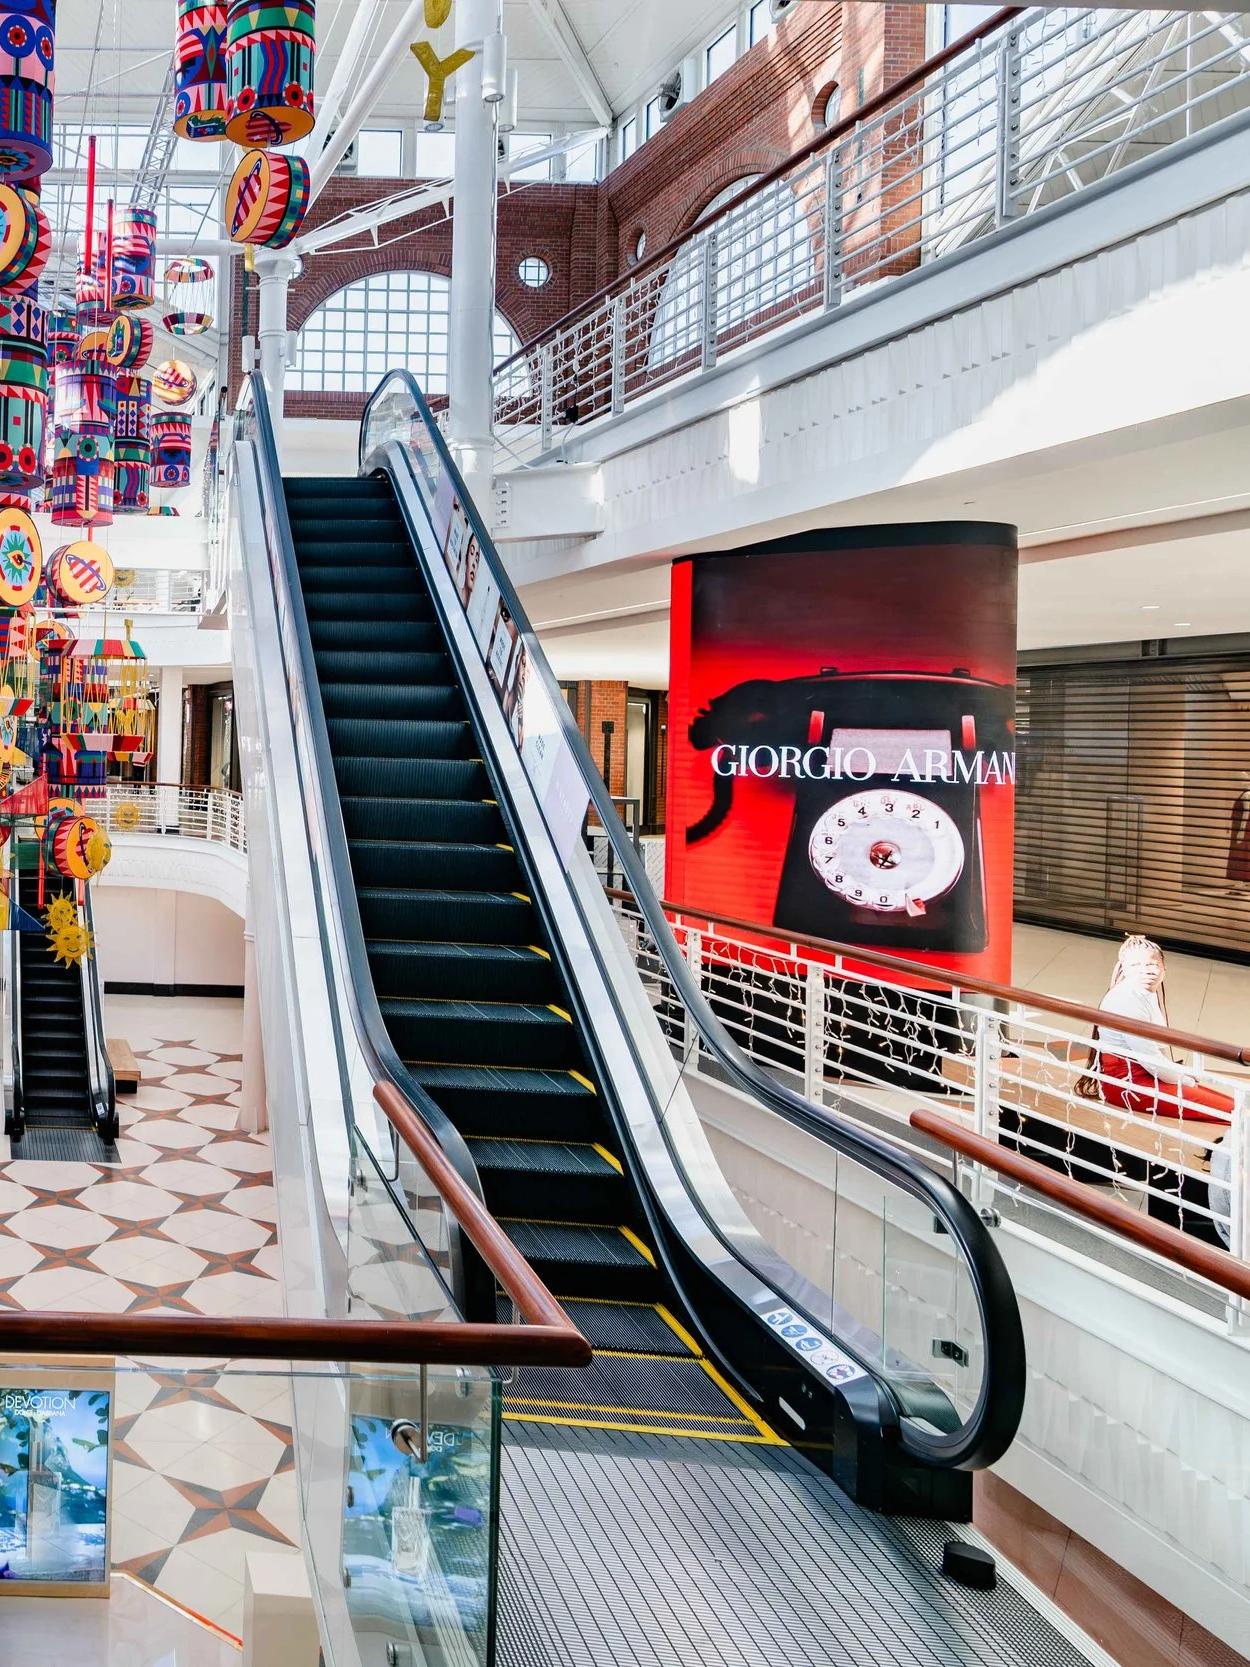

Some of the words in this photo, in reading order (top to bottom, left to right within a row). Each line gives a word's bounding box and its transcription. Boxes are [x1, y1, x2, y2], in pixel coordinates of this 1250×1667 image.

[710, 744, 877, 781] GIORGIO
[891, 748, 1016, 785] ARMAN
[858, 806, 867, 816] 4
[885, 803, 894, 813] 3
[911, 809, 921, 819] 2
[837, 818, 846, 827] 5
[934, 820, 940, 829] 1
[824, 836, 833, 845] 6
[824, 855, 834, 864] 7
[835, 874, 844, 883] 8
[854, 889, 863, 897] 9
[879, 895, 888, 904] 0
[5, 1395, 76, 1410] DEVOTION
